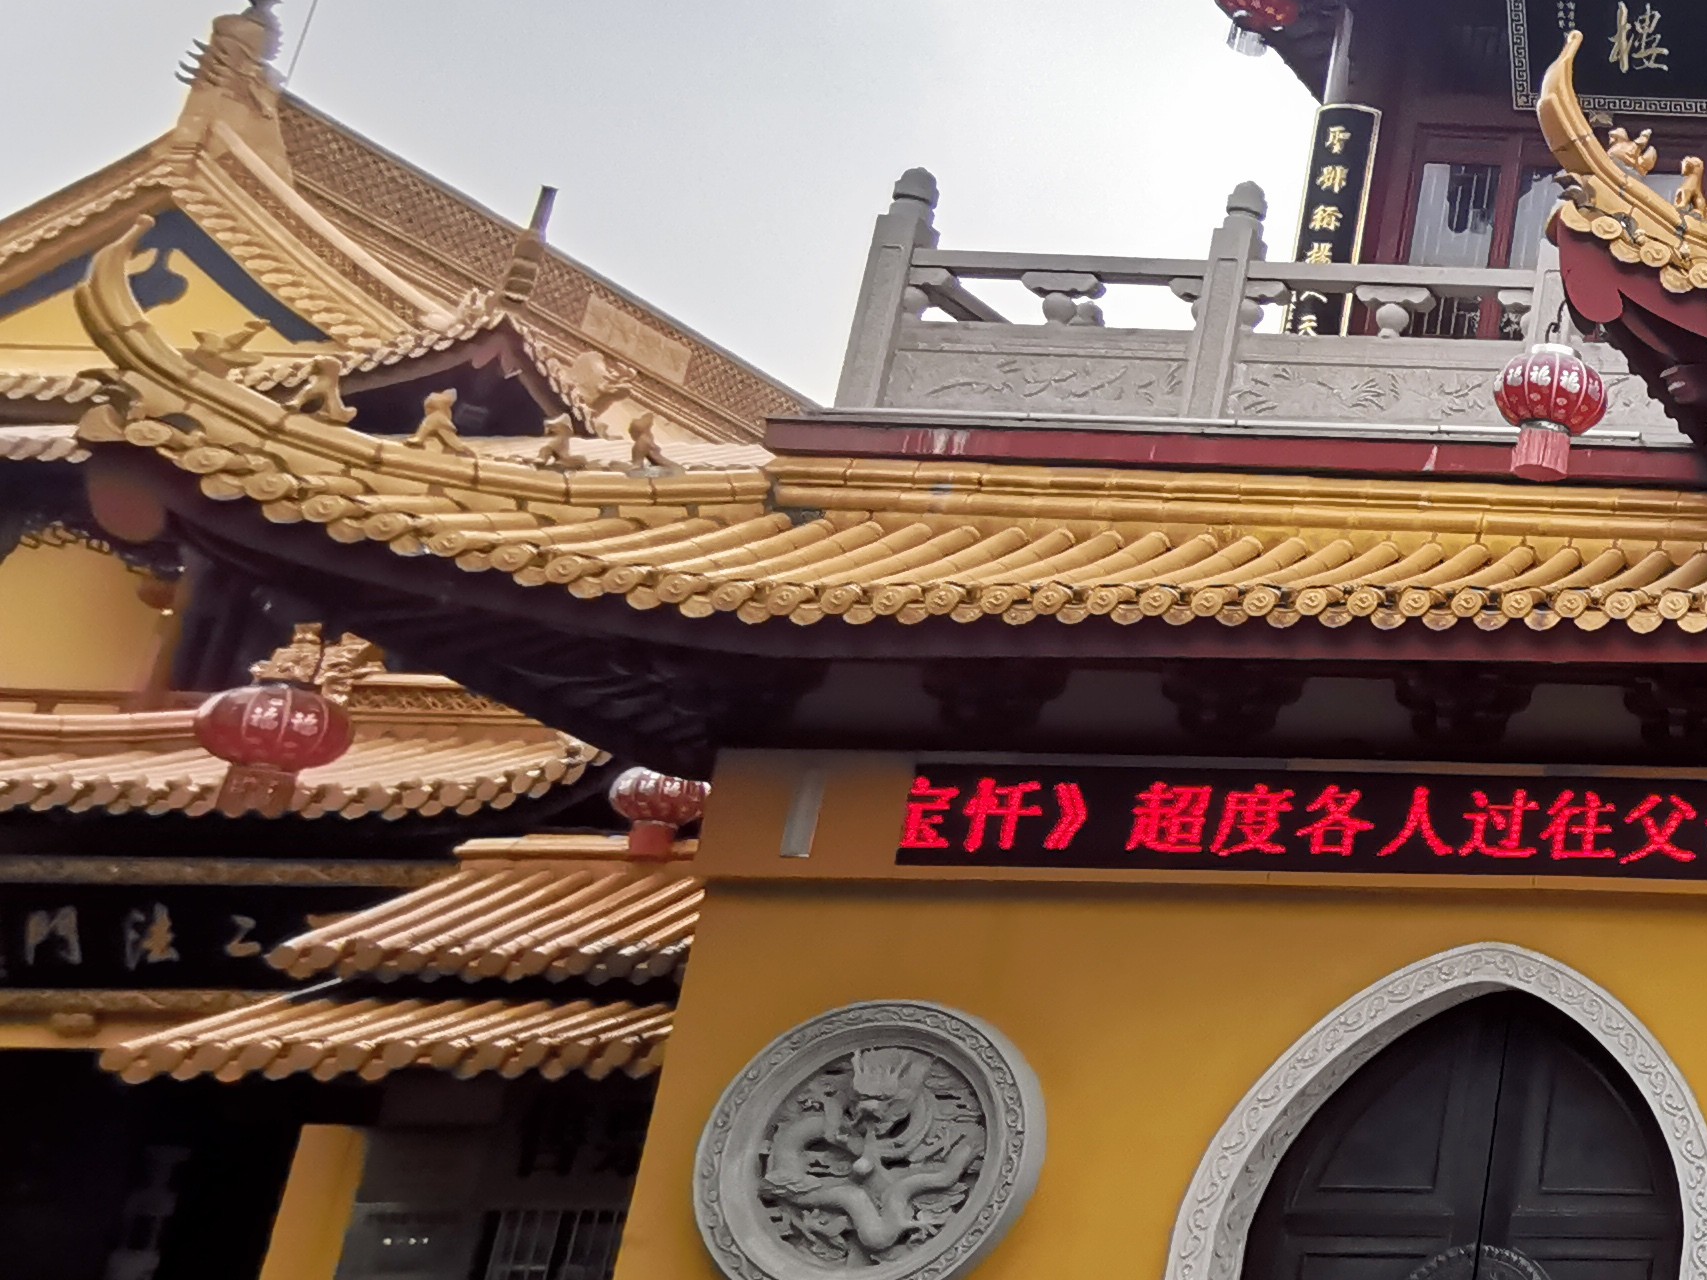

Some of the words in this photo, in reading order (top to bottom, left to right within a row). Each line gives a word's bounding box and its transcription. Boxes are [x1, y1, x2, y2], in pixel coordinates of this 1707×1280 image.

[1507, 365, 1523, 387] 福
[1530, 365, 1551, 387] 福
[1560, 370, 1581, 394] 福
